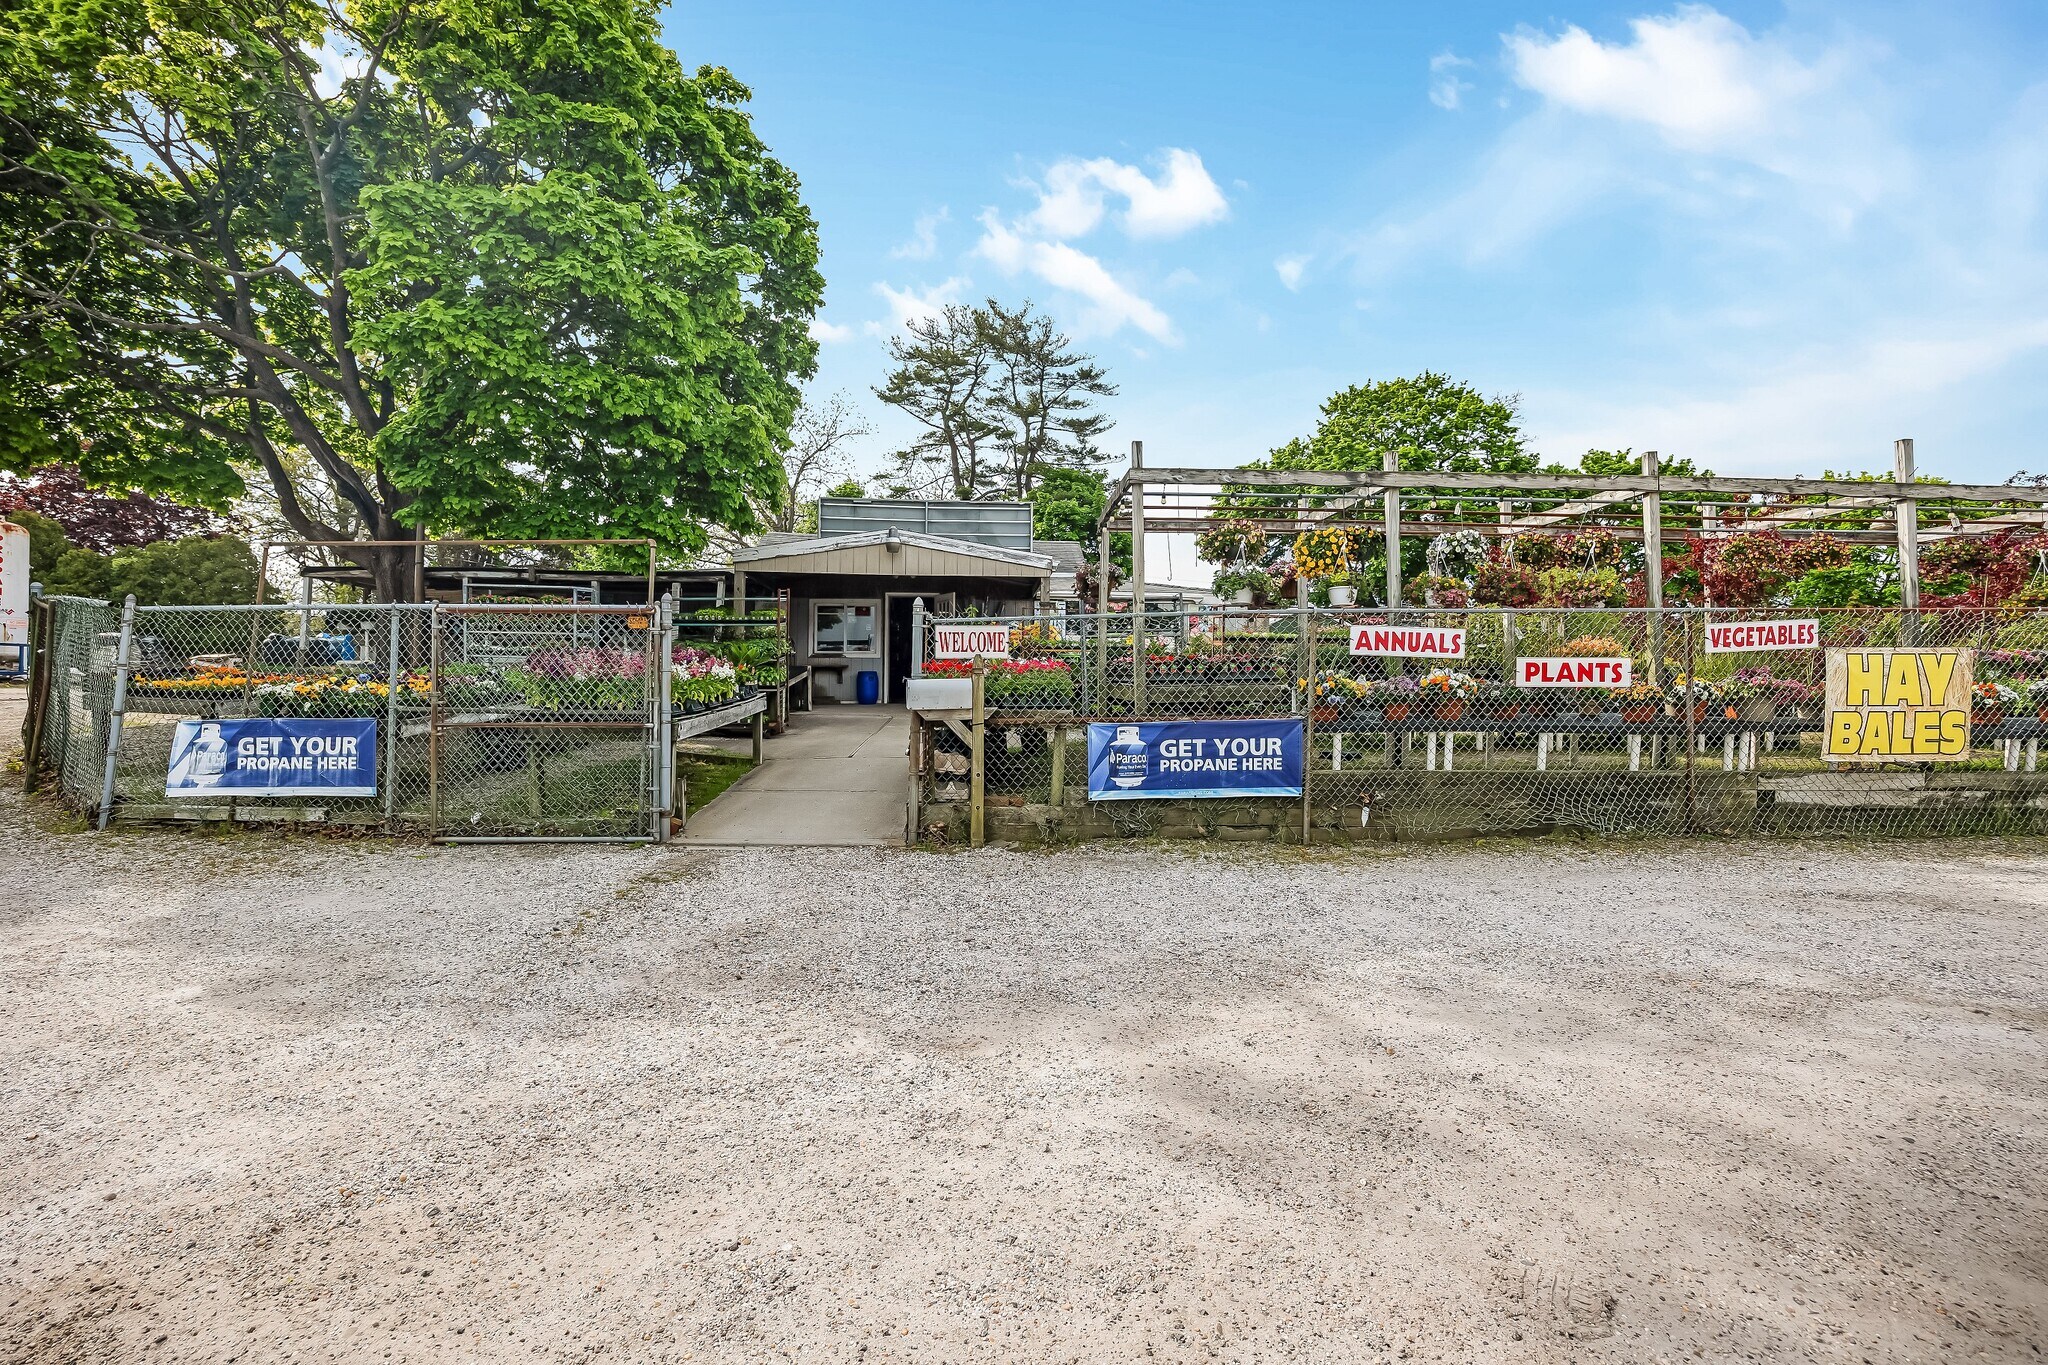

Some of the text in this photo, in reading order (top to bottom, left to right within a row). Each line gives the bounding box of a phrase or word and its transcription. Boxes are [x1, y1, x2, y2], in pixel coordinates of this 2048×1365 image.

[938, 631, 1005, 653] WELCOME
[1354, 630, 1461, 654] ANNUALS
[1710, 624, 1814, 648] VEGETABLES
[1525, 662, 1623, 683] PLANTS
[1846, 653, 1958, 706] HAY
[1829, 710, 1967, 755] BALES
[238, 736, 357, 756] GET YOUR
[1159, 737, 1283, 757] GET YOUR
[237, 757, 357, 770] PROPANE HERE
[1116, 753, 1147, 764] Paraco
[1160, 757, 1283, 772] PROPANE HERE
